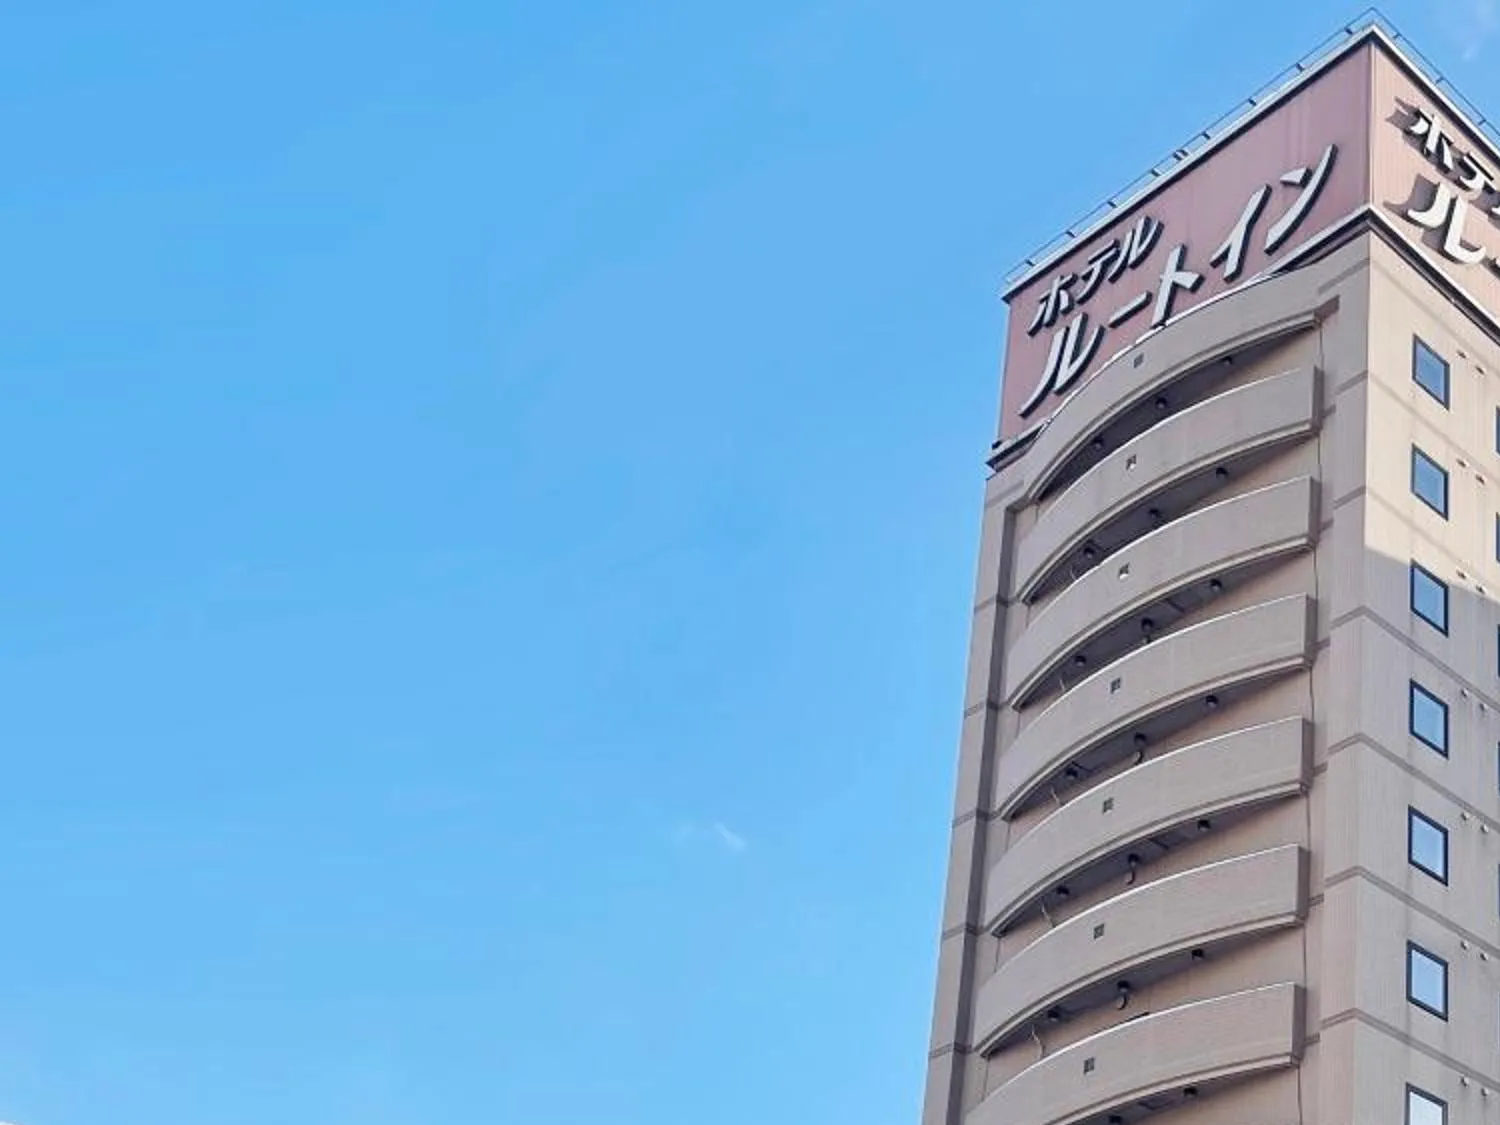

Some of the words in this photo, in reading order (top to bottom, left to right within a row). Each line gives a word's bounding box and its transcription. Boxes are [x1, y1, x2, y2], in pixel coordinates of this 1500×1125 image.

[1019, 144, 1339, 419] ルートイン
[1026, 215, 1164, 337] ホテル
